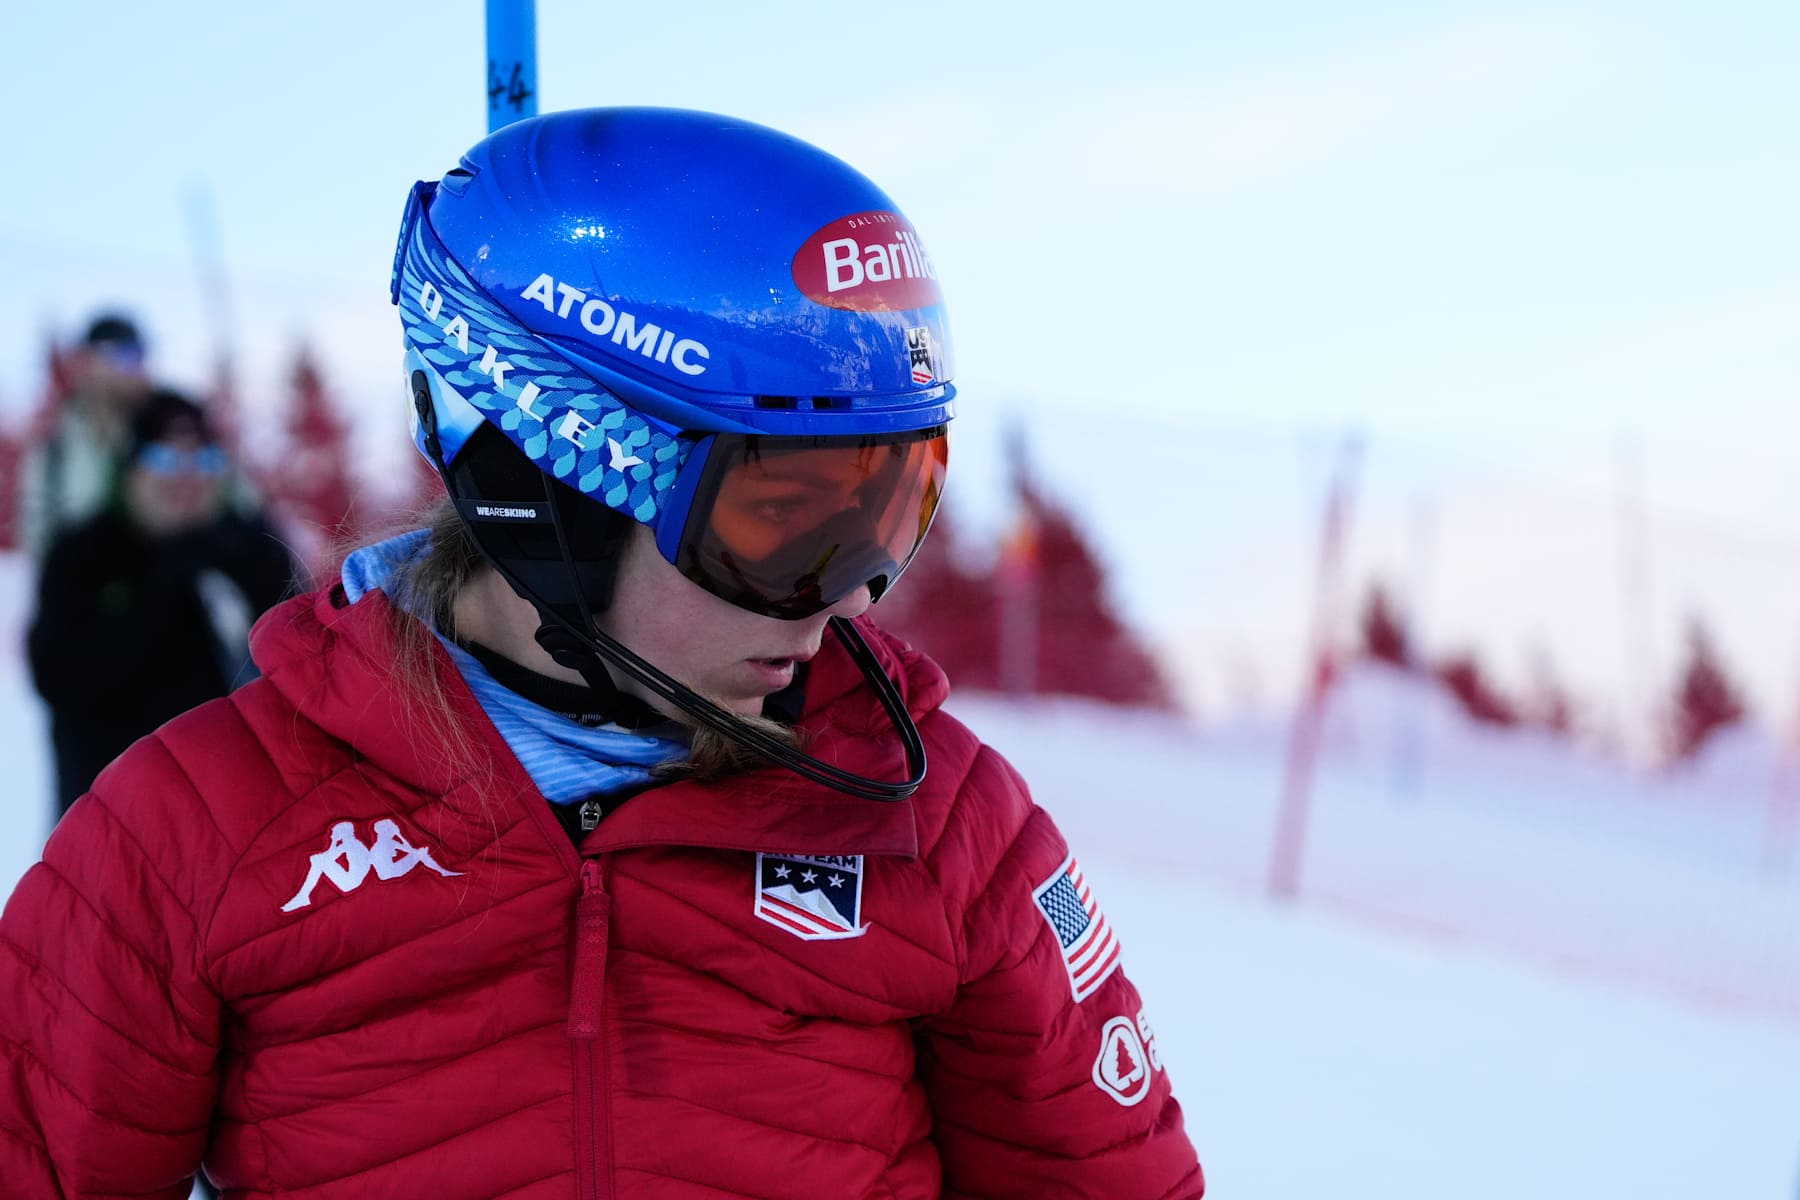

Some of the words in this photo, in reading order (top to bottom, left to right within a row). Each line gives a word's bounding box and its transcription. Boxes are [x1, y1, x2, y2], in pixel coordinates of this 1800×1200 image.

[848, 216, 872, 228] DAL
[520, 273, 710, 376] ATOMIC
[420, 280, 644, 473] OAKLEY
